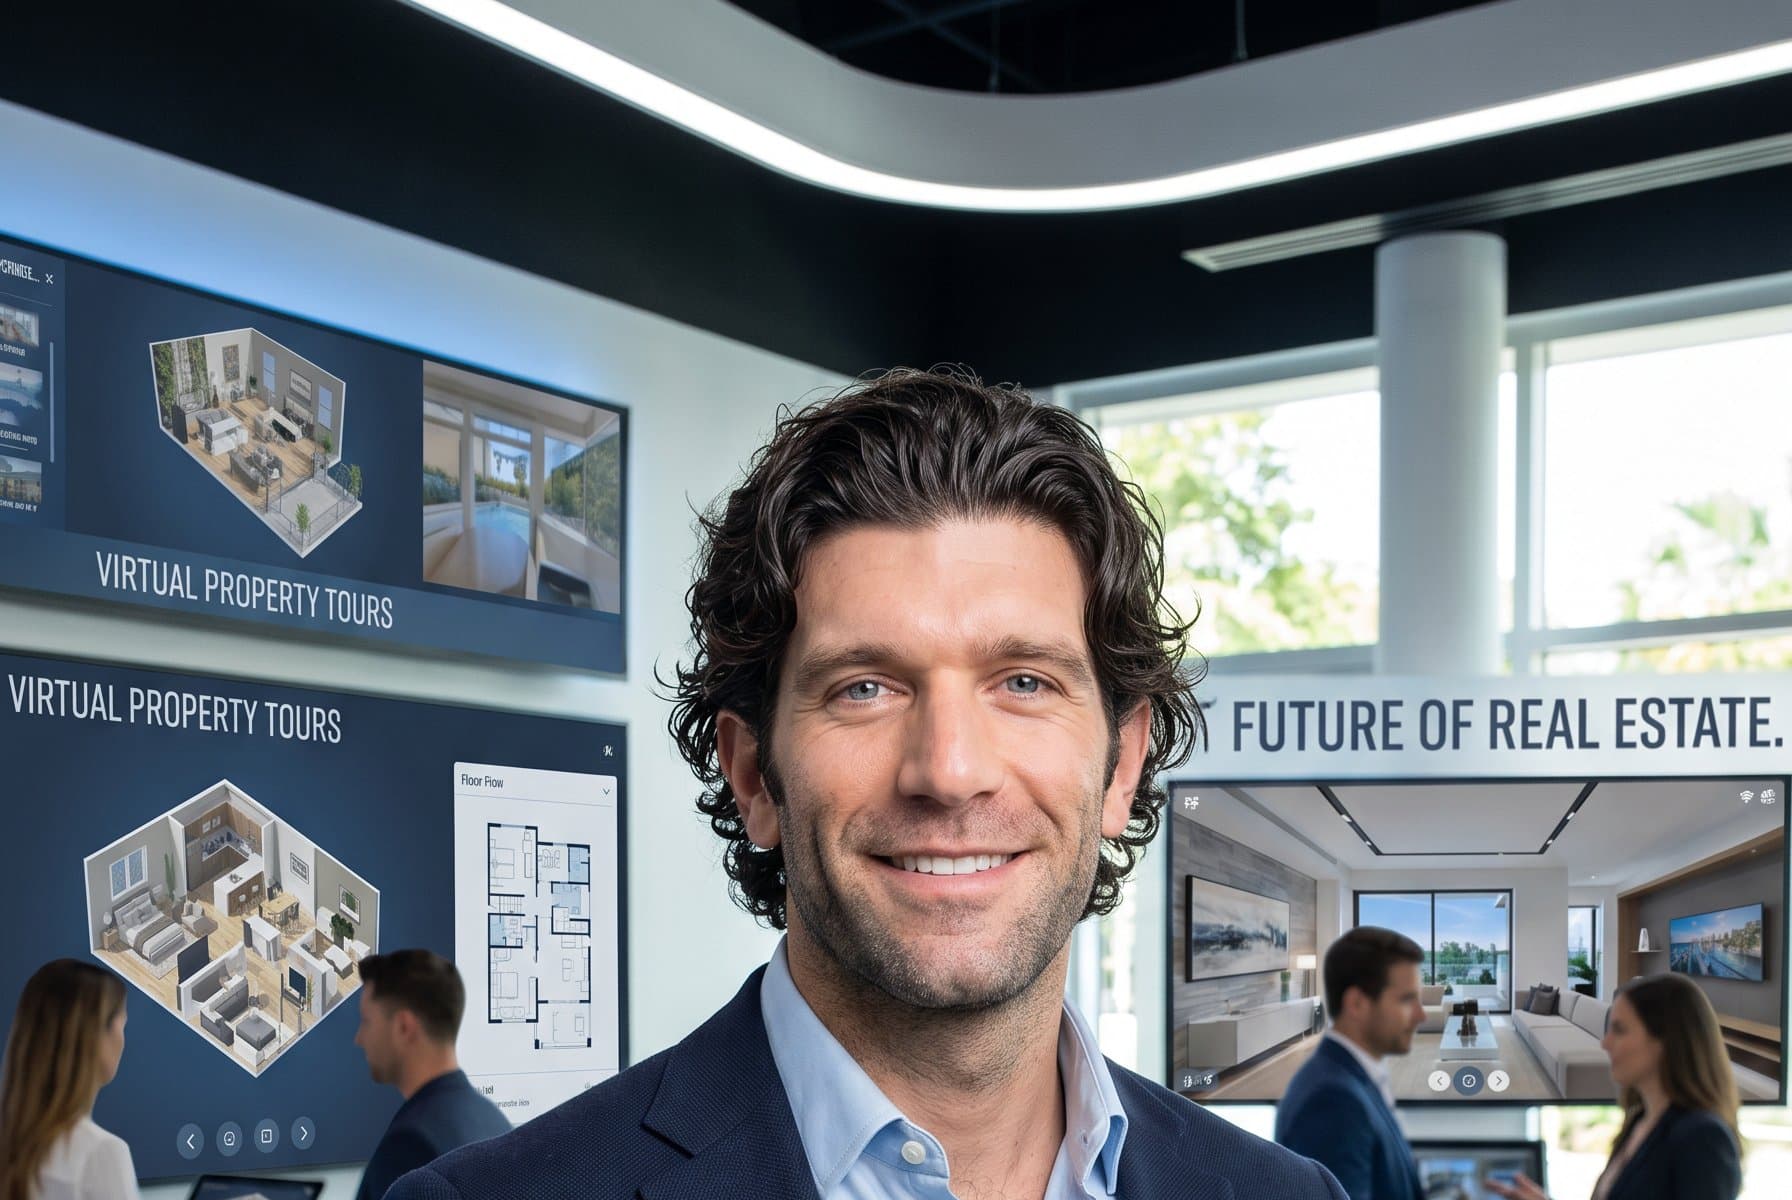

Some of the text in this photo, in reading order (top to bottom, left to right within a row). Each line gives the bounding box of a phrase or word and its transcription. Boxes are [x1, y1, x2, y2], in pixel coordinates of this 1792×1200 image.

[96, 551, 394, 629] VIRTUAL PROPERTY TOURS
[8, 674, 342, 744] VIRTUAL PROPERTY TOURS
[1233, 697, 1783, 752] FUTURE OF REAL ESTATE.
